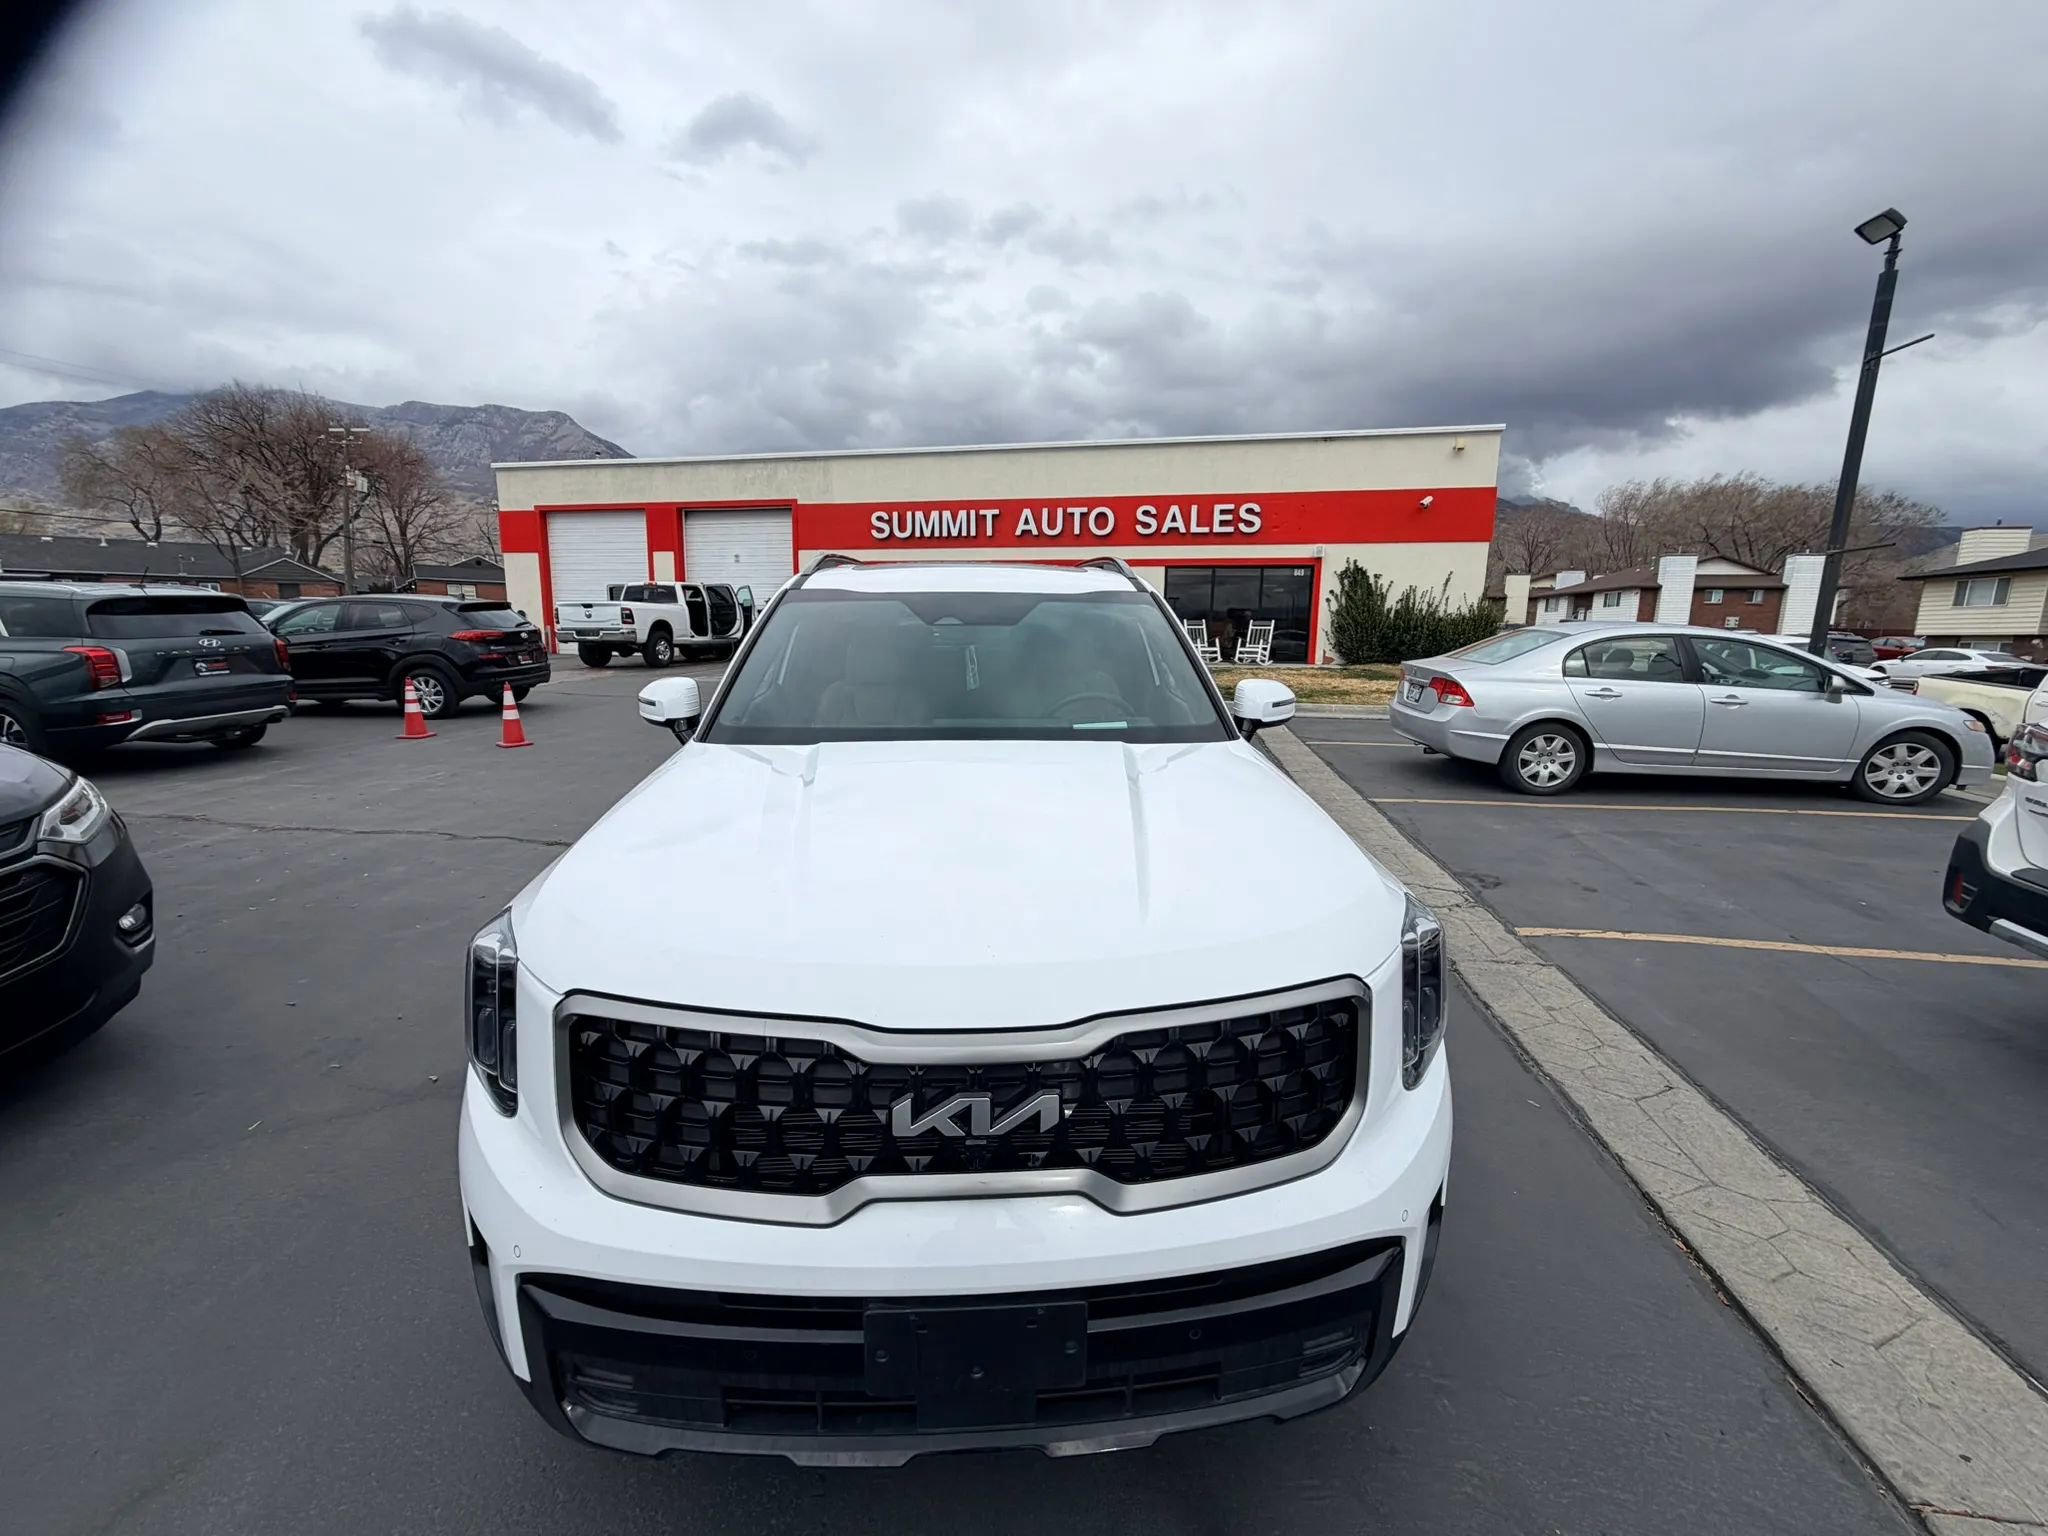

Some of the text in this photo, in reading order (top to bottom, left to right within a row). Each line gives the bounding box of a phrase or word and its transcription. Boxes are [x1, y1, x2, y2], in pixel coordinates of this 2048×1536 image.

[870, 502, 1263, 540] SUMMIT AUTO SALES
[891, 1089, 1061, 1137] KIA
